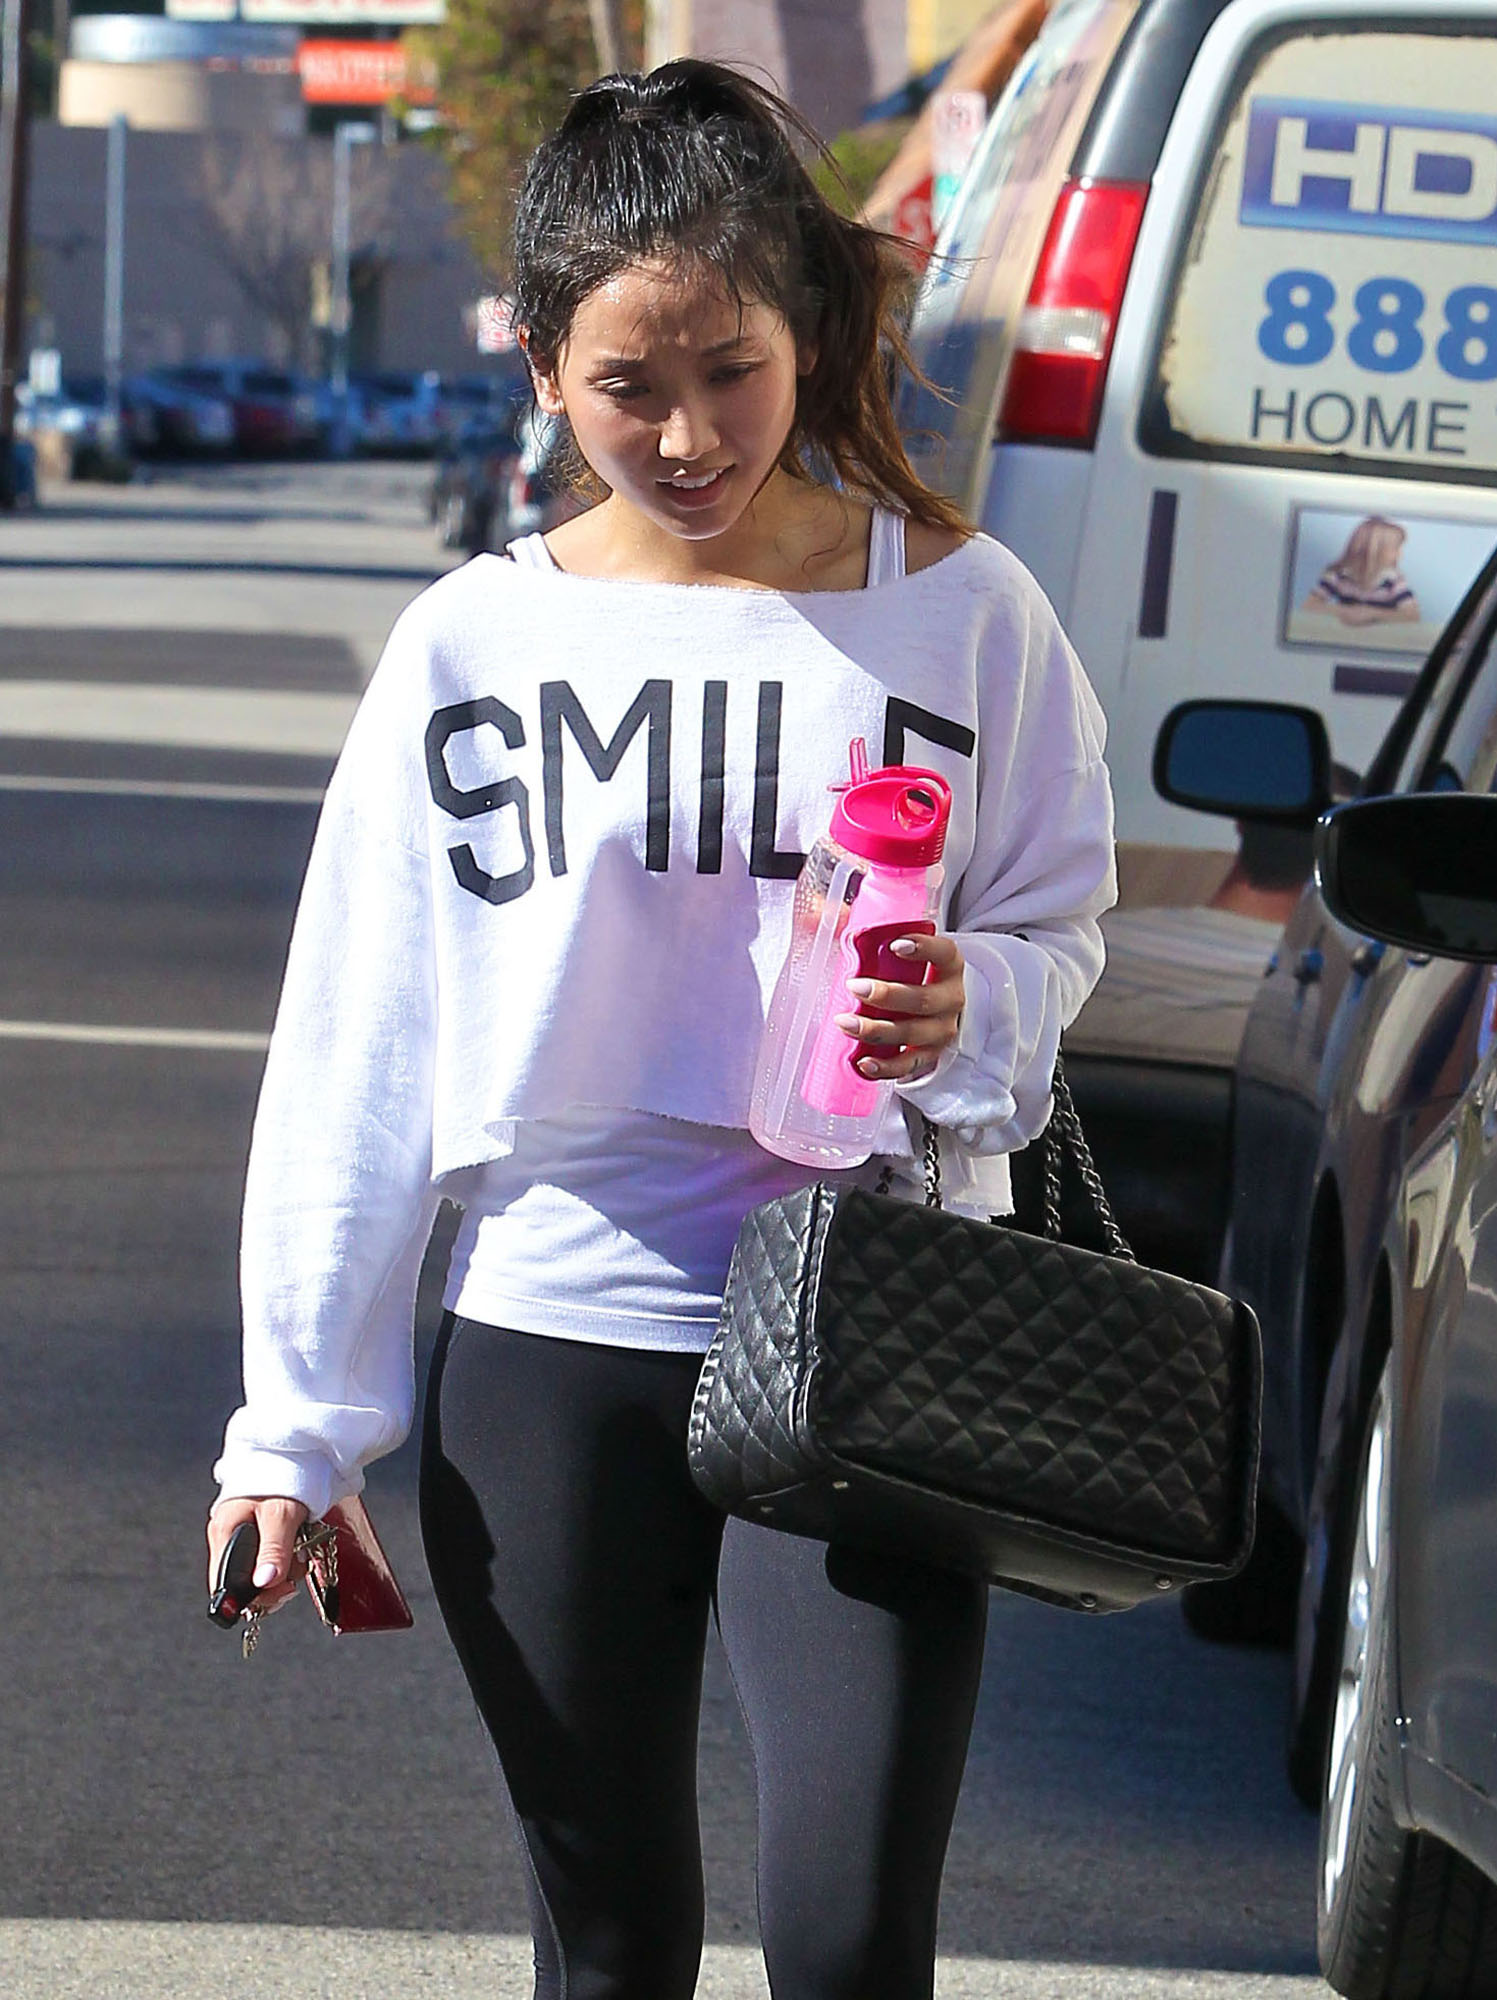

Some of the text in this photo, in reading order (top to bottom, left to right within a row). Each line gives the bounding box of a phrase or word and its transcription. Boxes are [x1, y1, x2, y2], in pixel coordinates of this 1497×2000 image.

[1271, 116, 1497, 221] HD
[1257, 268, 1497, 382] 888
[1251, 387, 1469, 455] HOME
